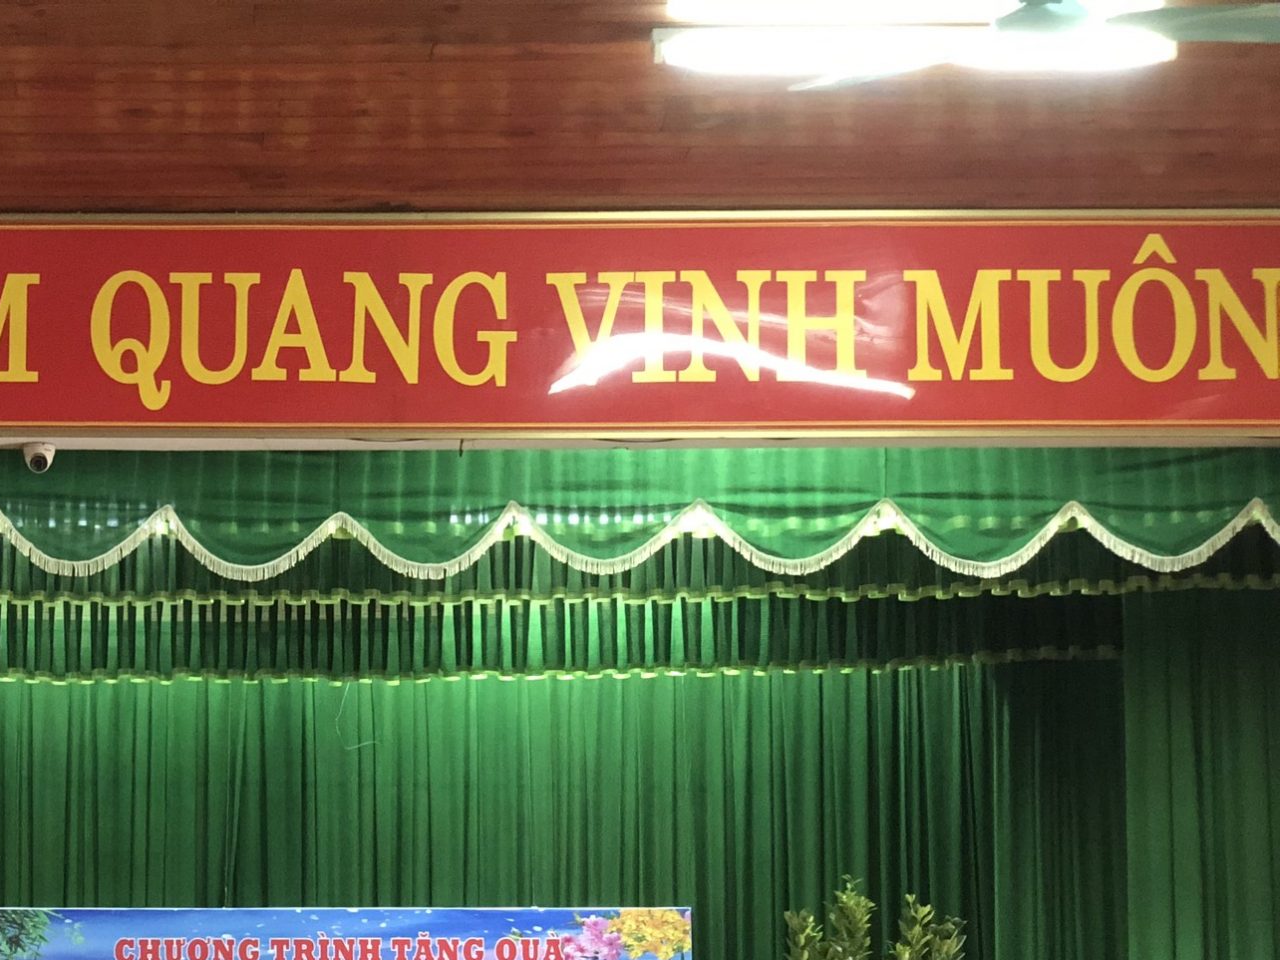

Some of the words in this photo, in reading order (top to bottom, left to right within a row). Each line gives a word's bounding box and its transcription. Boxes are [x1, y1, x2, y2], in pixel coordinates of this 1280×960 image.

[92, 269, 517, 410] QUANG
[547, 269, 868, 385] VINH
[903, 234, 1280, 383] MUÔN
